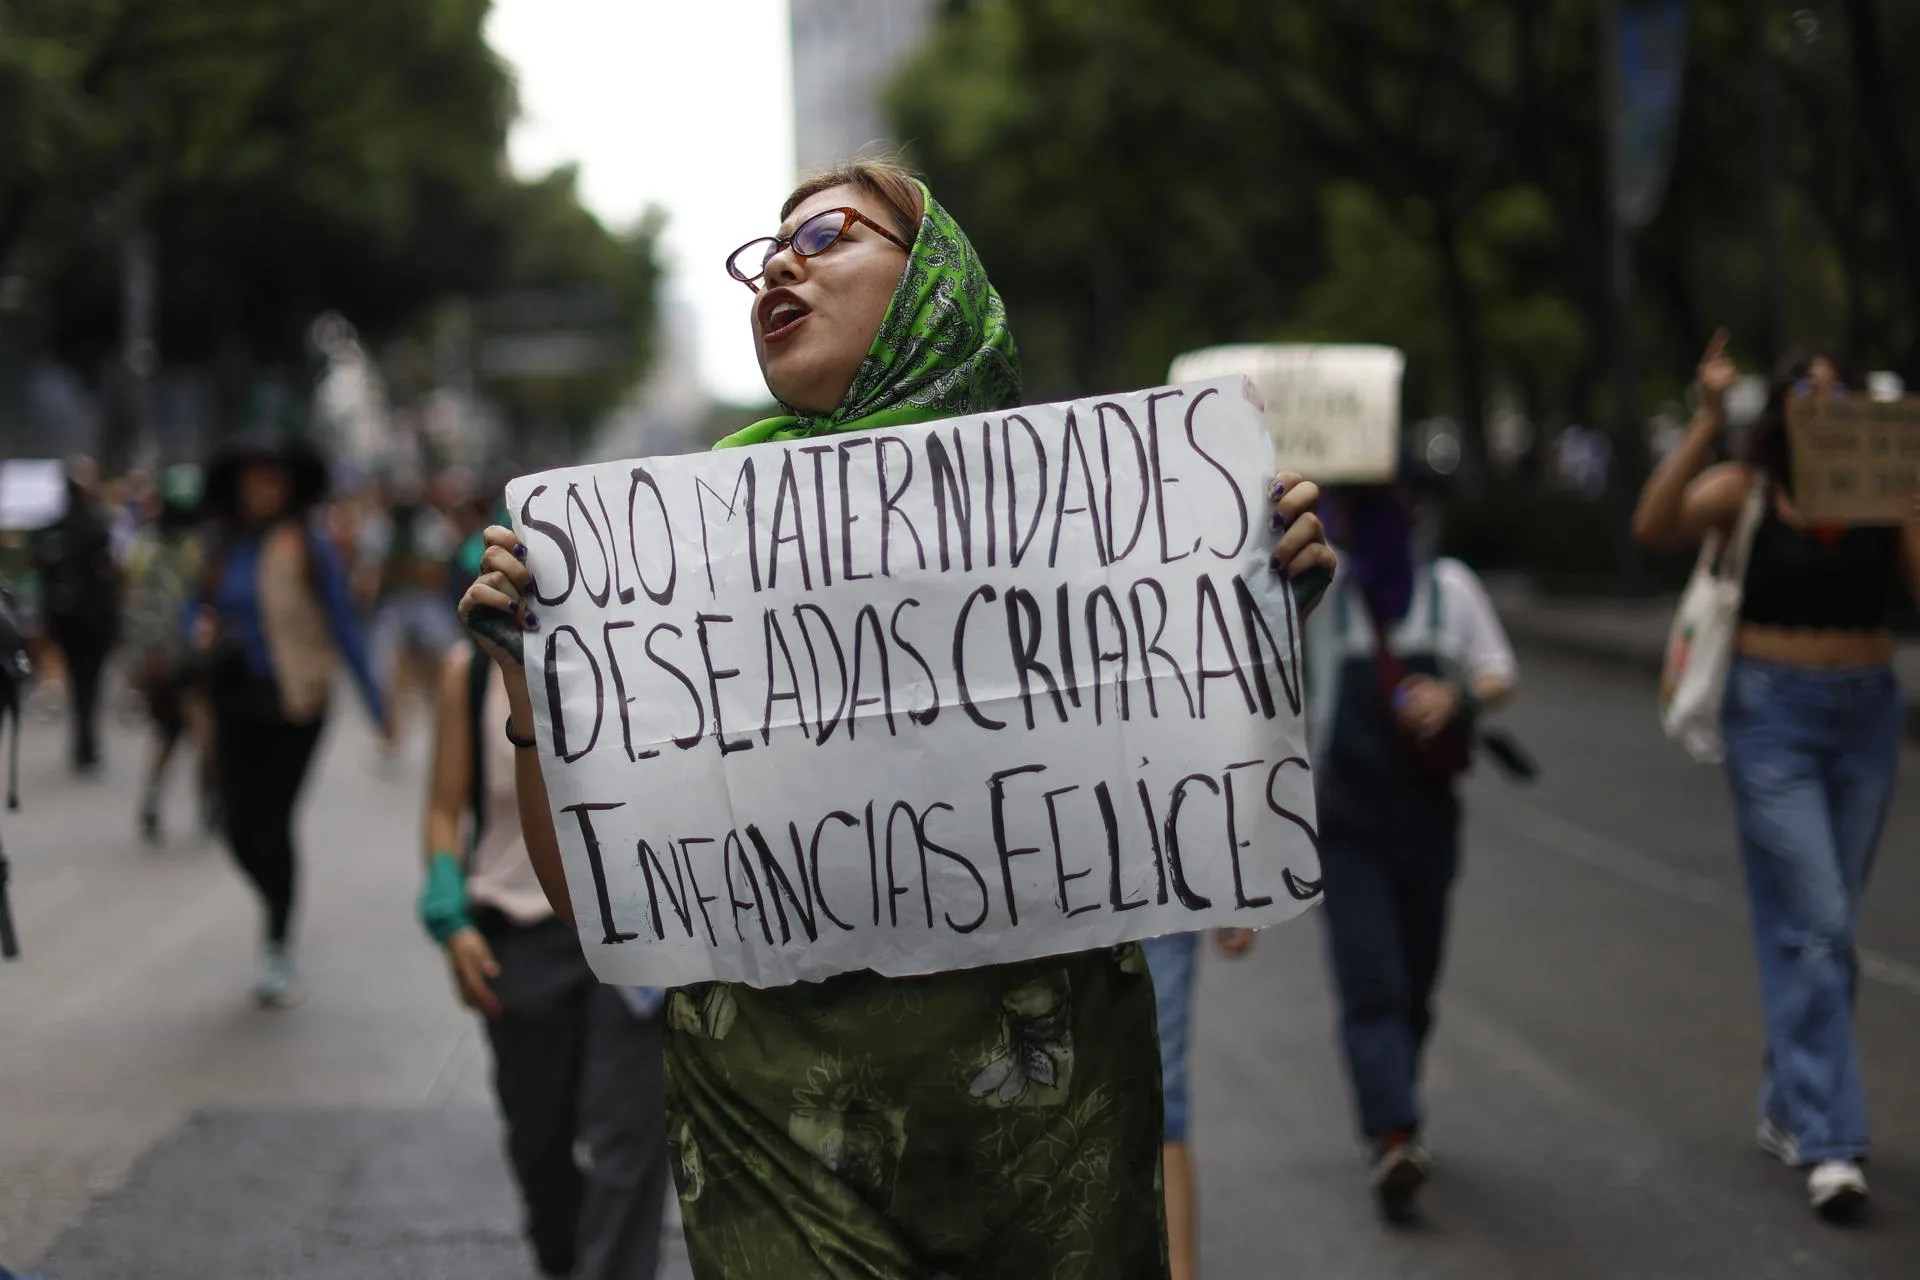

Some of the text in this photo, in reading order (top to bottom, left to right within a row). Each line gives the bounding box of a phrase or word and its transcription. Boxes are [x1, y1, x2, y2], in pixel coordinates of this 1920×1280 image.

[520, 388, 1248, 607] SOLO MATERNIDADES
[543, 573, 1303, 763] DESEADAS CRIARAN
[560, 800, 988, 946] INFANCIAS
